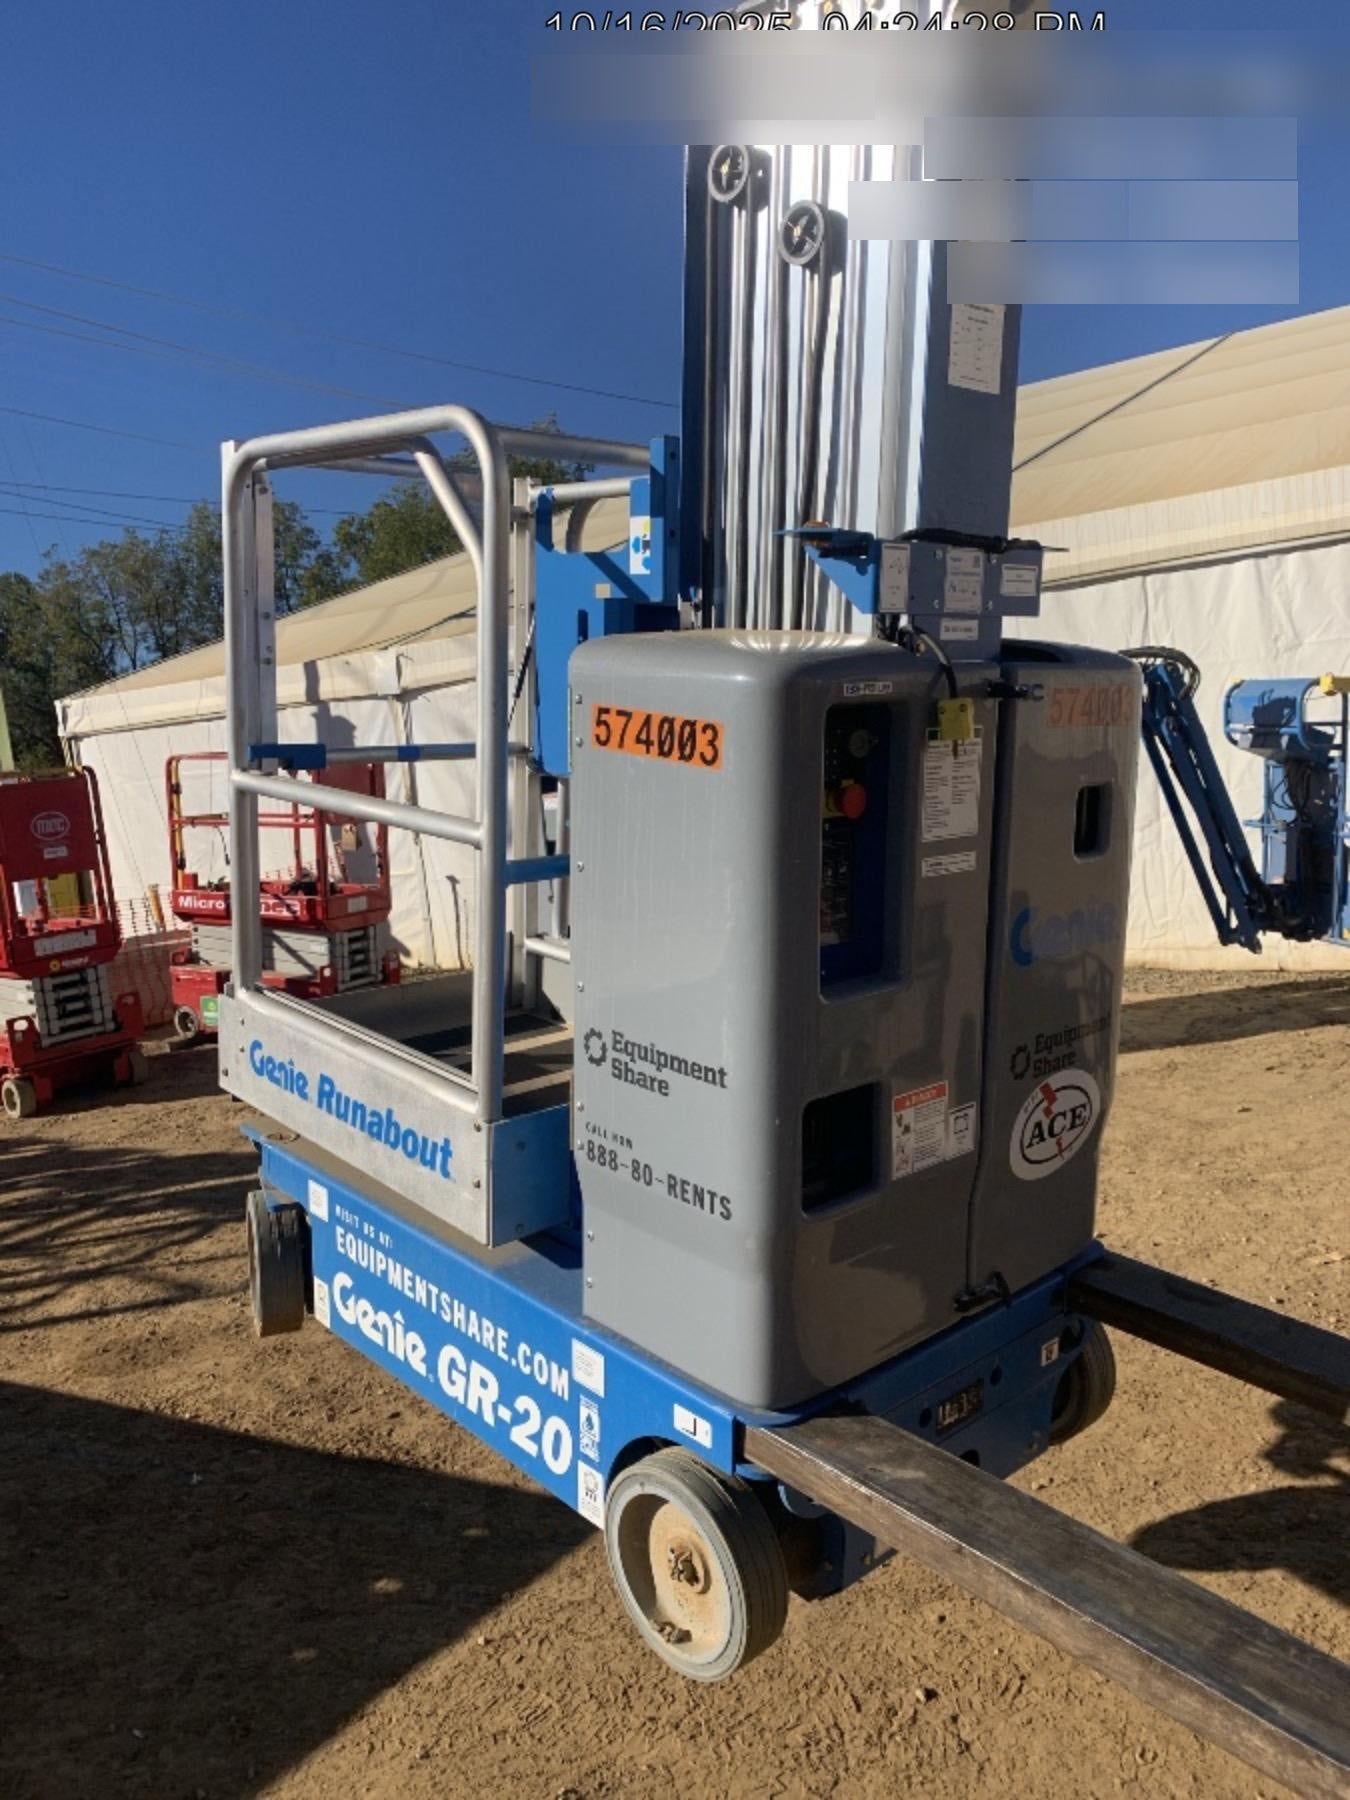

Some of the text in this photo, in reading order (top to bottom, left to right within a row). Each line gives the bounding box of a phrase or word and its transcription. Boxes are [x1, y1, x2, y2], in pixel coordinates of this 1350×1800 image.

[594, 706, 720, 767] 574003
[177, 895, 226, 910] Micro
[611, 1029, 728, 1090] Equipment
[611, 1057, 670, 1098] Share
[249, 1039, 454, 1180] Genie Runabout
[1025, 1104, 1087, 1150] ACE
[335, 1224, 569, 1402] EQUIPMENTSHARE.COM
[333, 1271, 427, 1378] Genie
[437, 1343, 573, 1476] GR-20
